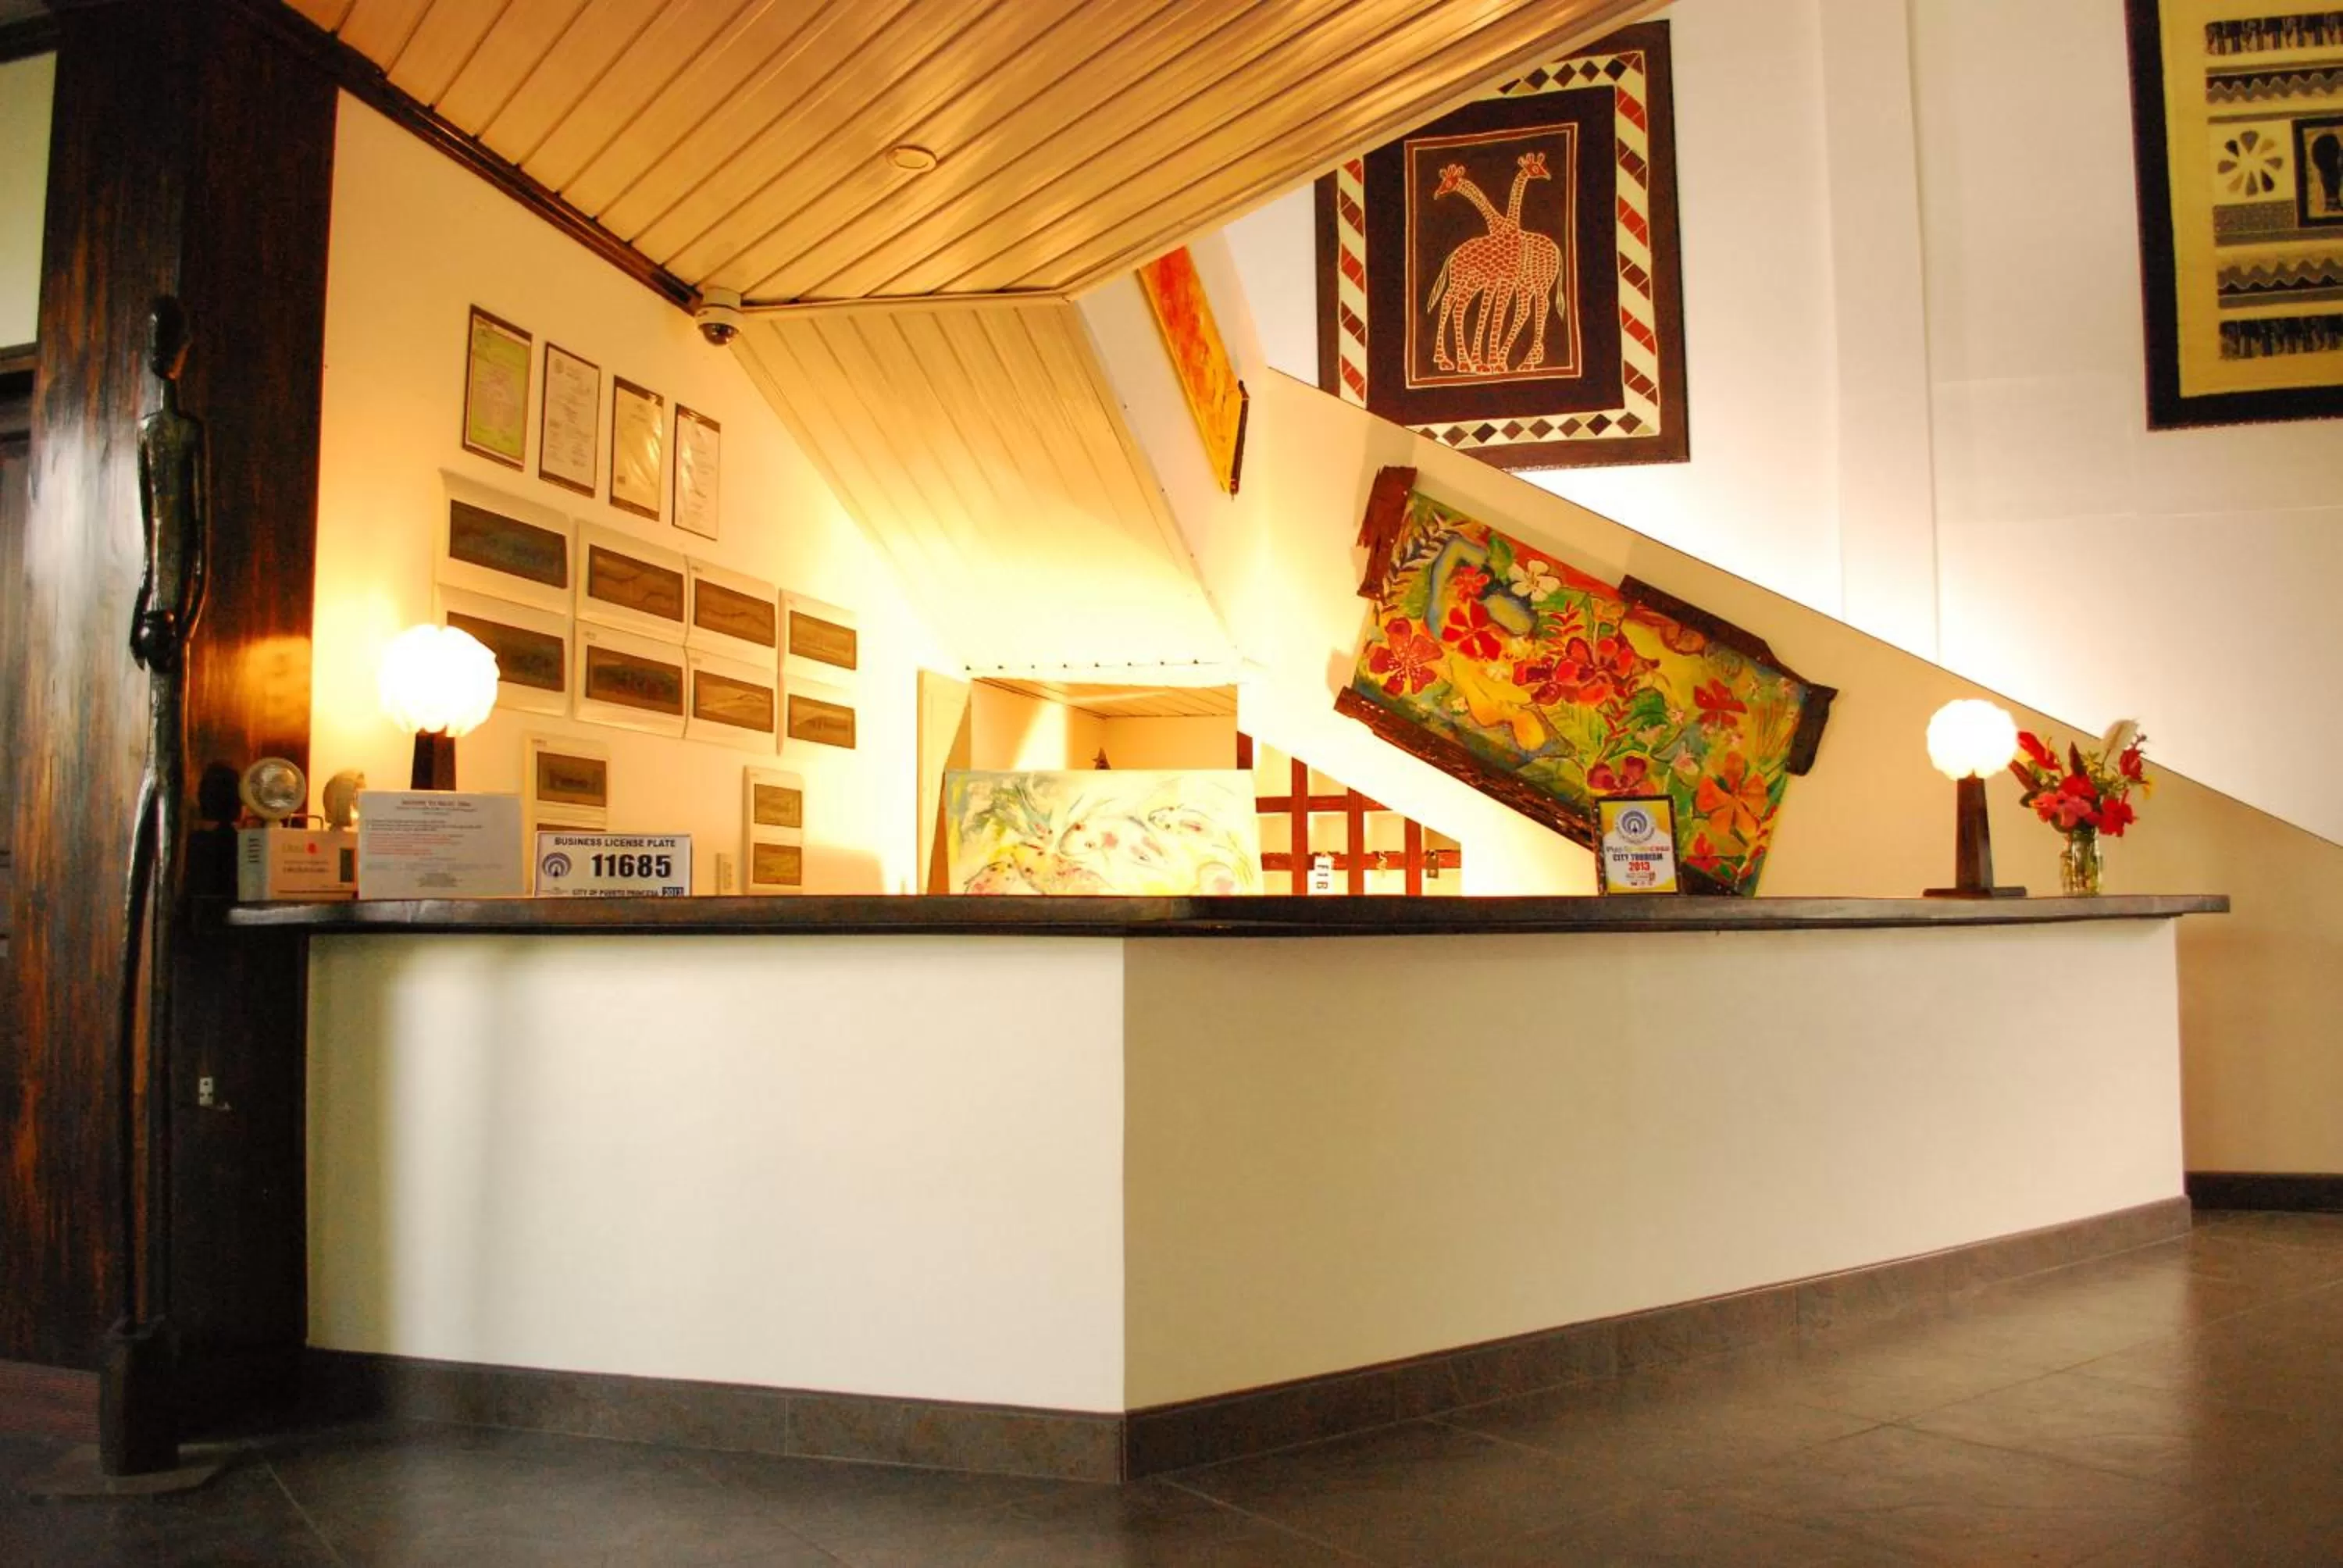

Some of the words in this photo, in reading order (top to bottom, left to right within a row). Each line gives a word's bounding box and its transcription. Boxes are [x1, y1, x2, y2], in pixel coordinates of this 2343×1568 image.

[555, 836, 602, 846] BUSINESS
[604, 838, 644, 847] LICENSE
[647, 839, 676, 848] PLATE
[591, 853, 672, 878] 11685
[1628, 862, 1650, 871] 2013
